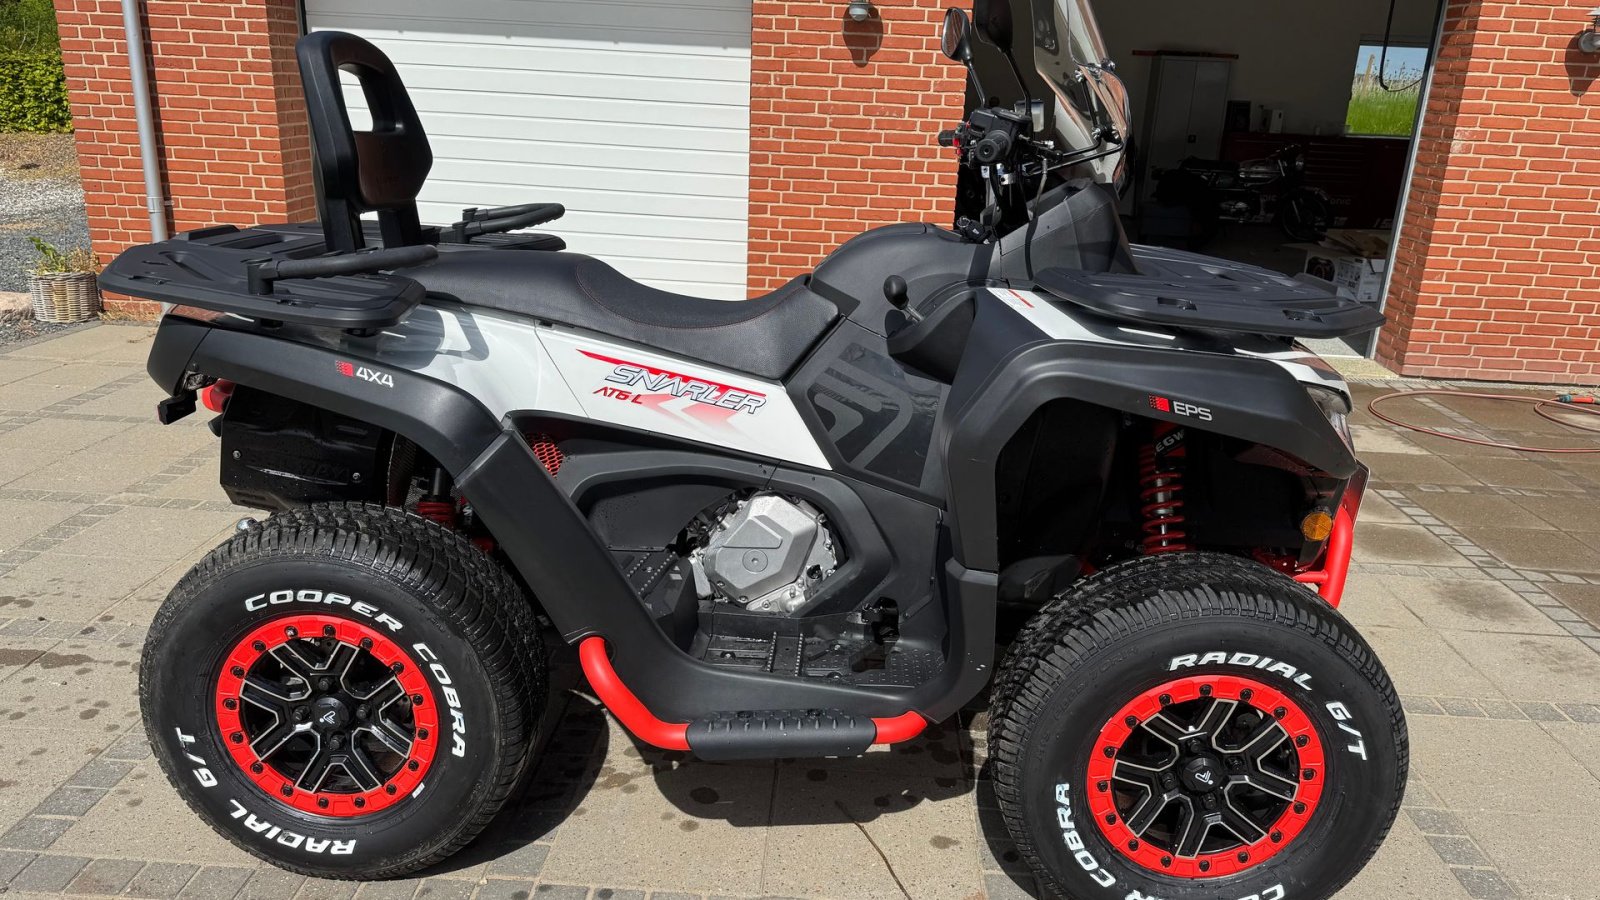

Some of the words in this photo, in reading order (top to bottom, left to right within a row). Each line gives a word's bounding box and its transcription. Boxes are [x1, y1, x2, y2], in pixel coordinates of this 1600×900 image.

[356, 367, 394, 388] 4X4
[604, 365, 767, 414] SNARLER
[1172, 400, 1213, 421] EPS
[1155, 429, 1185, 454] EGW
[245, 589, 404, 632] COOPER
[413, 642, 466, 758] COBRA
[1169, 651, 1313, 691] RADIAL
[1325, 701, 1368, 761] G/T
[175, 727, 218, 788] G/T
[229, 799, 357, 855] RADIAL
[1055, 783, 1116, 888] COBRA
